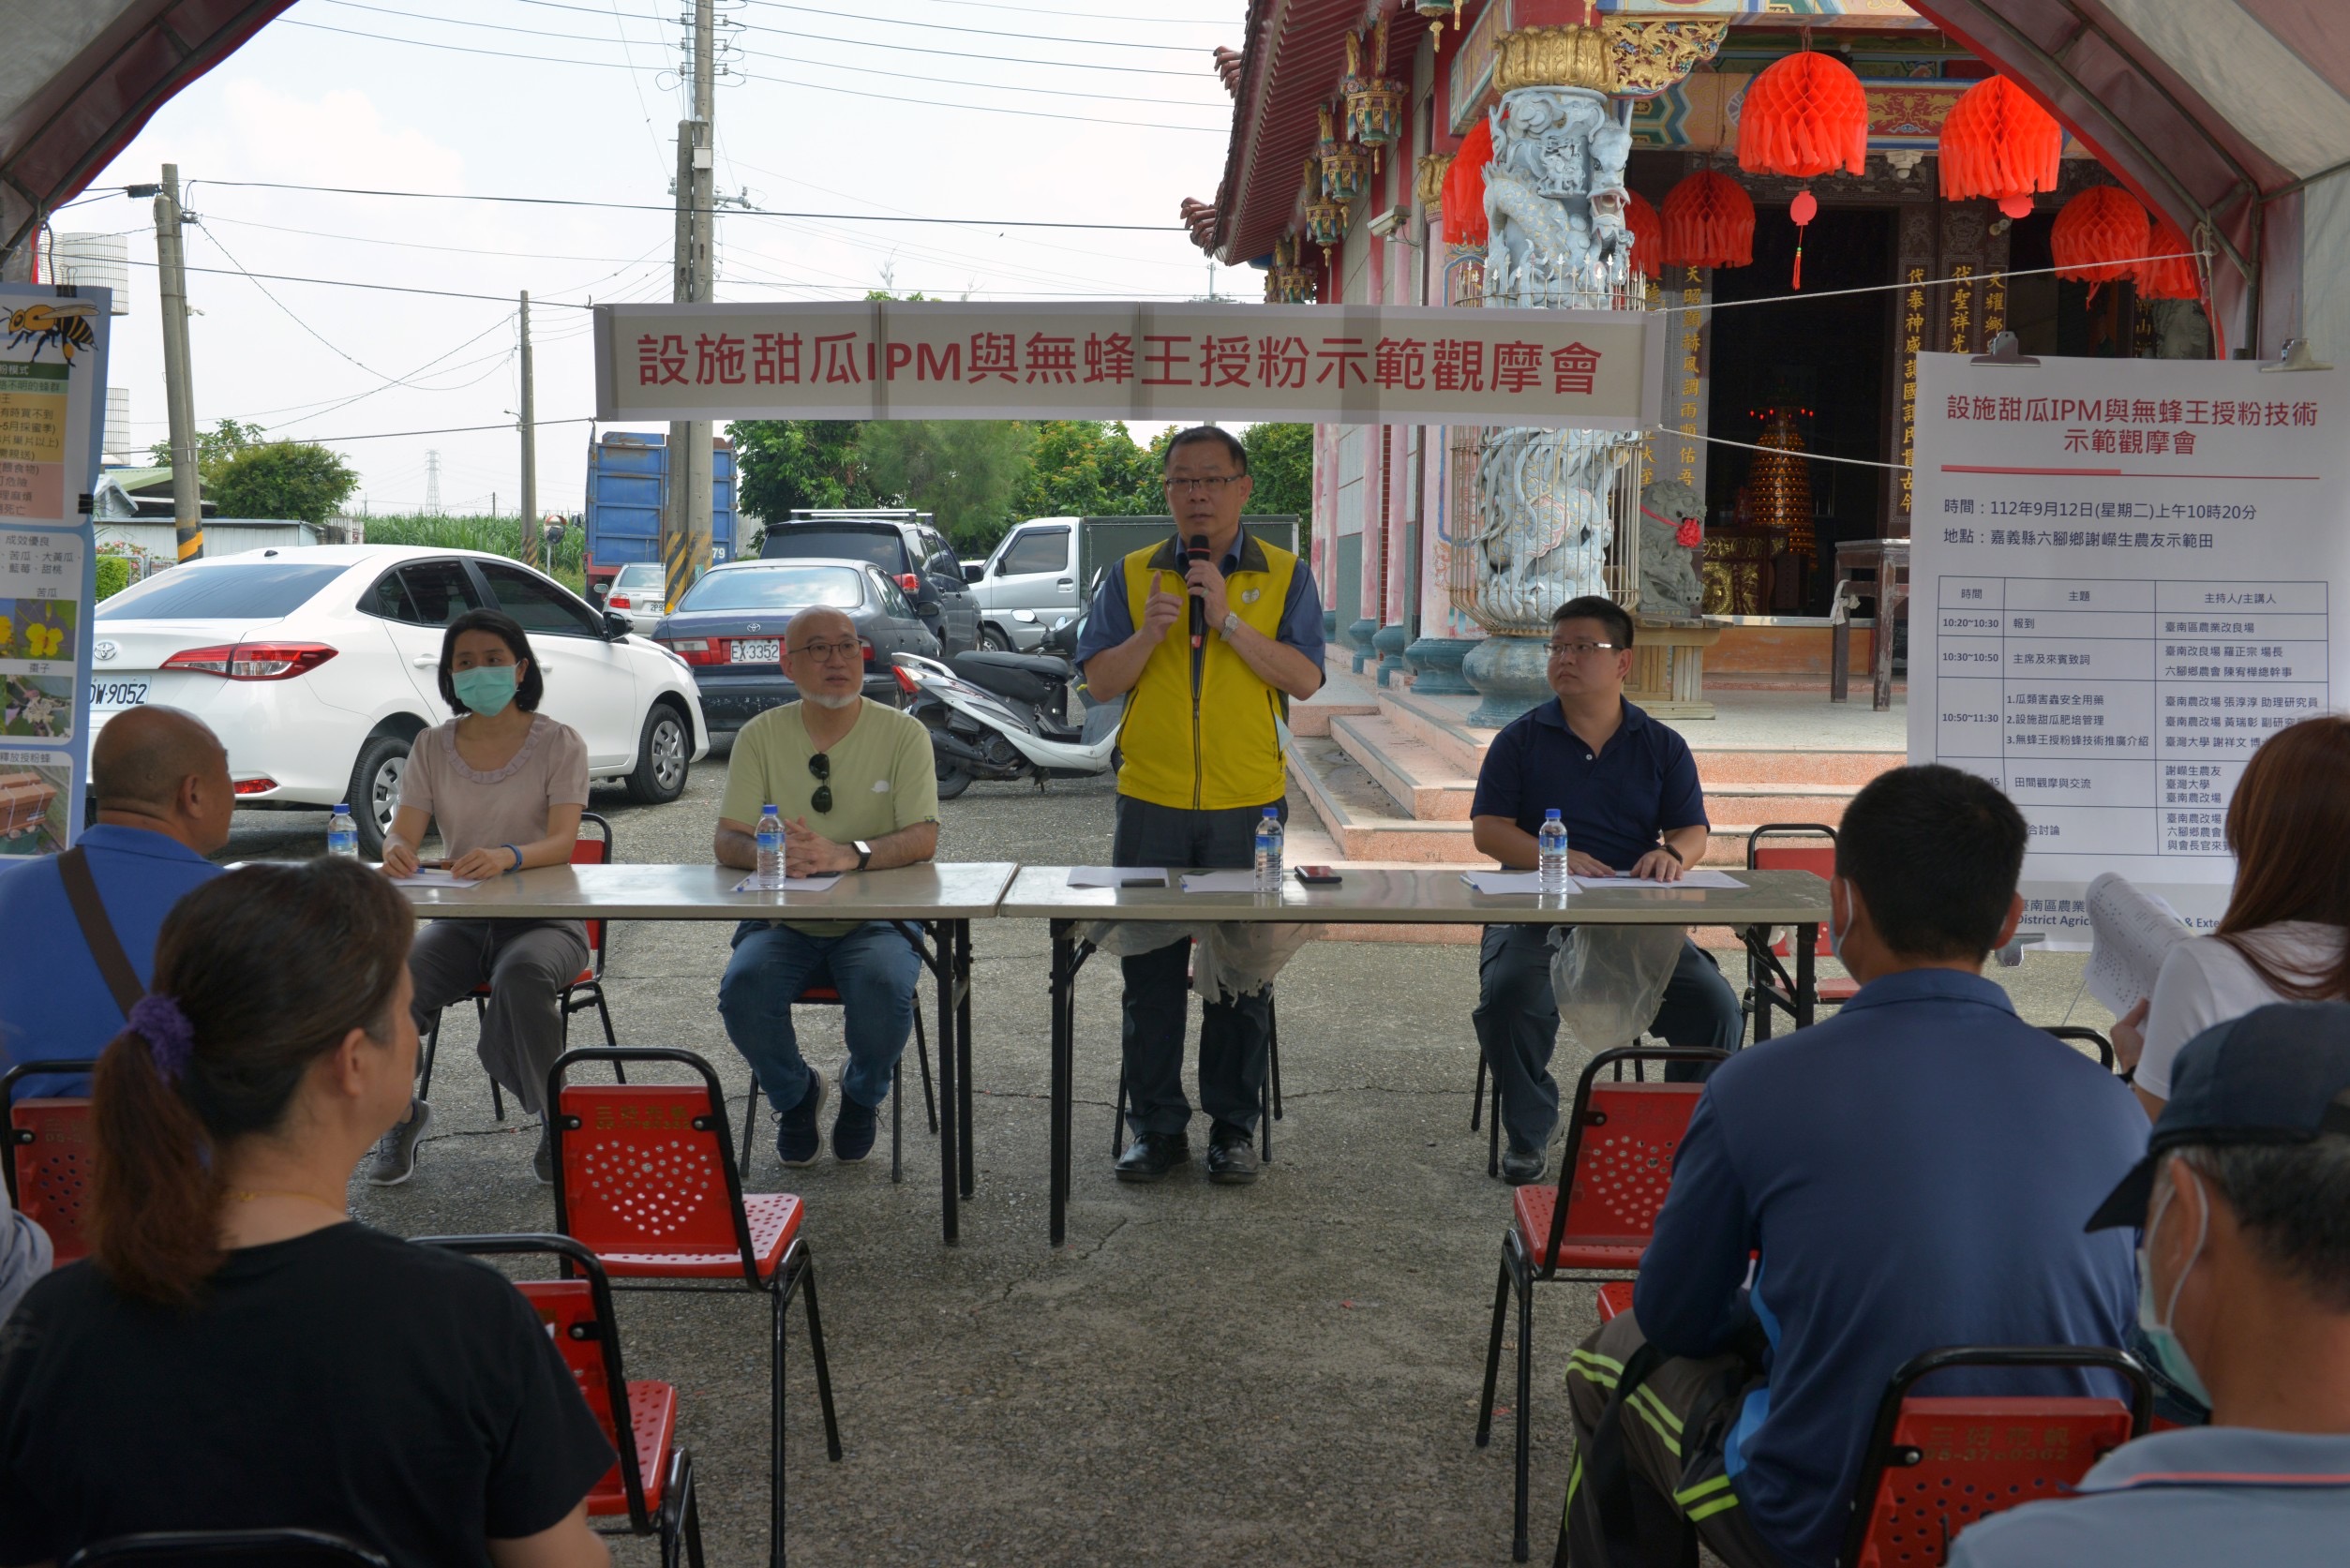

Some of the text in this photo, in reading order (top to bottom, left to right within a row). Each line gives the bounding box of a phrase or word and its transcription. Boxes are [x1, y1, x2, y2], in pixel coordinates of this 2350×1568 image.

[636, 330, 1603, 396] 設施甜瓜IPM與無蜂王授粉示範觀摩會
[1947, 395, 2318, 427] 設施甜瓜IPM與無蜂王授粉技術
[2063, 428, 2197, 455] 示範觀摩會
[1960, 589, 1983, 600] 時間
[2068, 590, 2090, 602] 主題
[2204, 592, 2277, 605] 主持人/主講人
[1942, 619, 1999, 629] 10:20~10:30
[2013, 618, 2035, 630] 報到
[2164, 621, 2255, 634] 臺南區農業改良場
[2164, 645, 2221, 657] 臺南改良場
[2261, 646, 2283, 658] 場長
[1942, 652, 1999, 664] 10:30~10:50
[2013, 653, 2090, 666] 主席及來賓致詞
[2164, 665, 2221, 678] 六腳鄉農會
[2164, 695, 2222, 709] 臺南農改場
[1942, 713, 1999, 724] 10:50~11:30
[2006, 714, 2104, 726] 2.設施甜瓜肥培管理
[2164, 716, 2222, 728] 臺南農改場
[2164, 737, 2210, 748] 臺灣大學
[2014, 777, 2092, 789] 田間觀摩與交流
[2165, 779, 2210, 790] 臺灣大學
[2166, 792, 2222, 803] 臺南農改場
[2166, 813, 2223, 825] 臺南農改場
[2167, 827, 2222, 838] 六腳鄉農會
